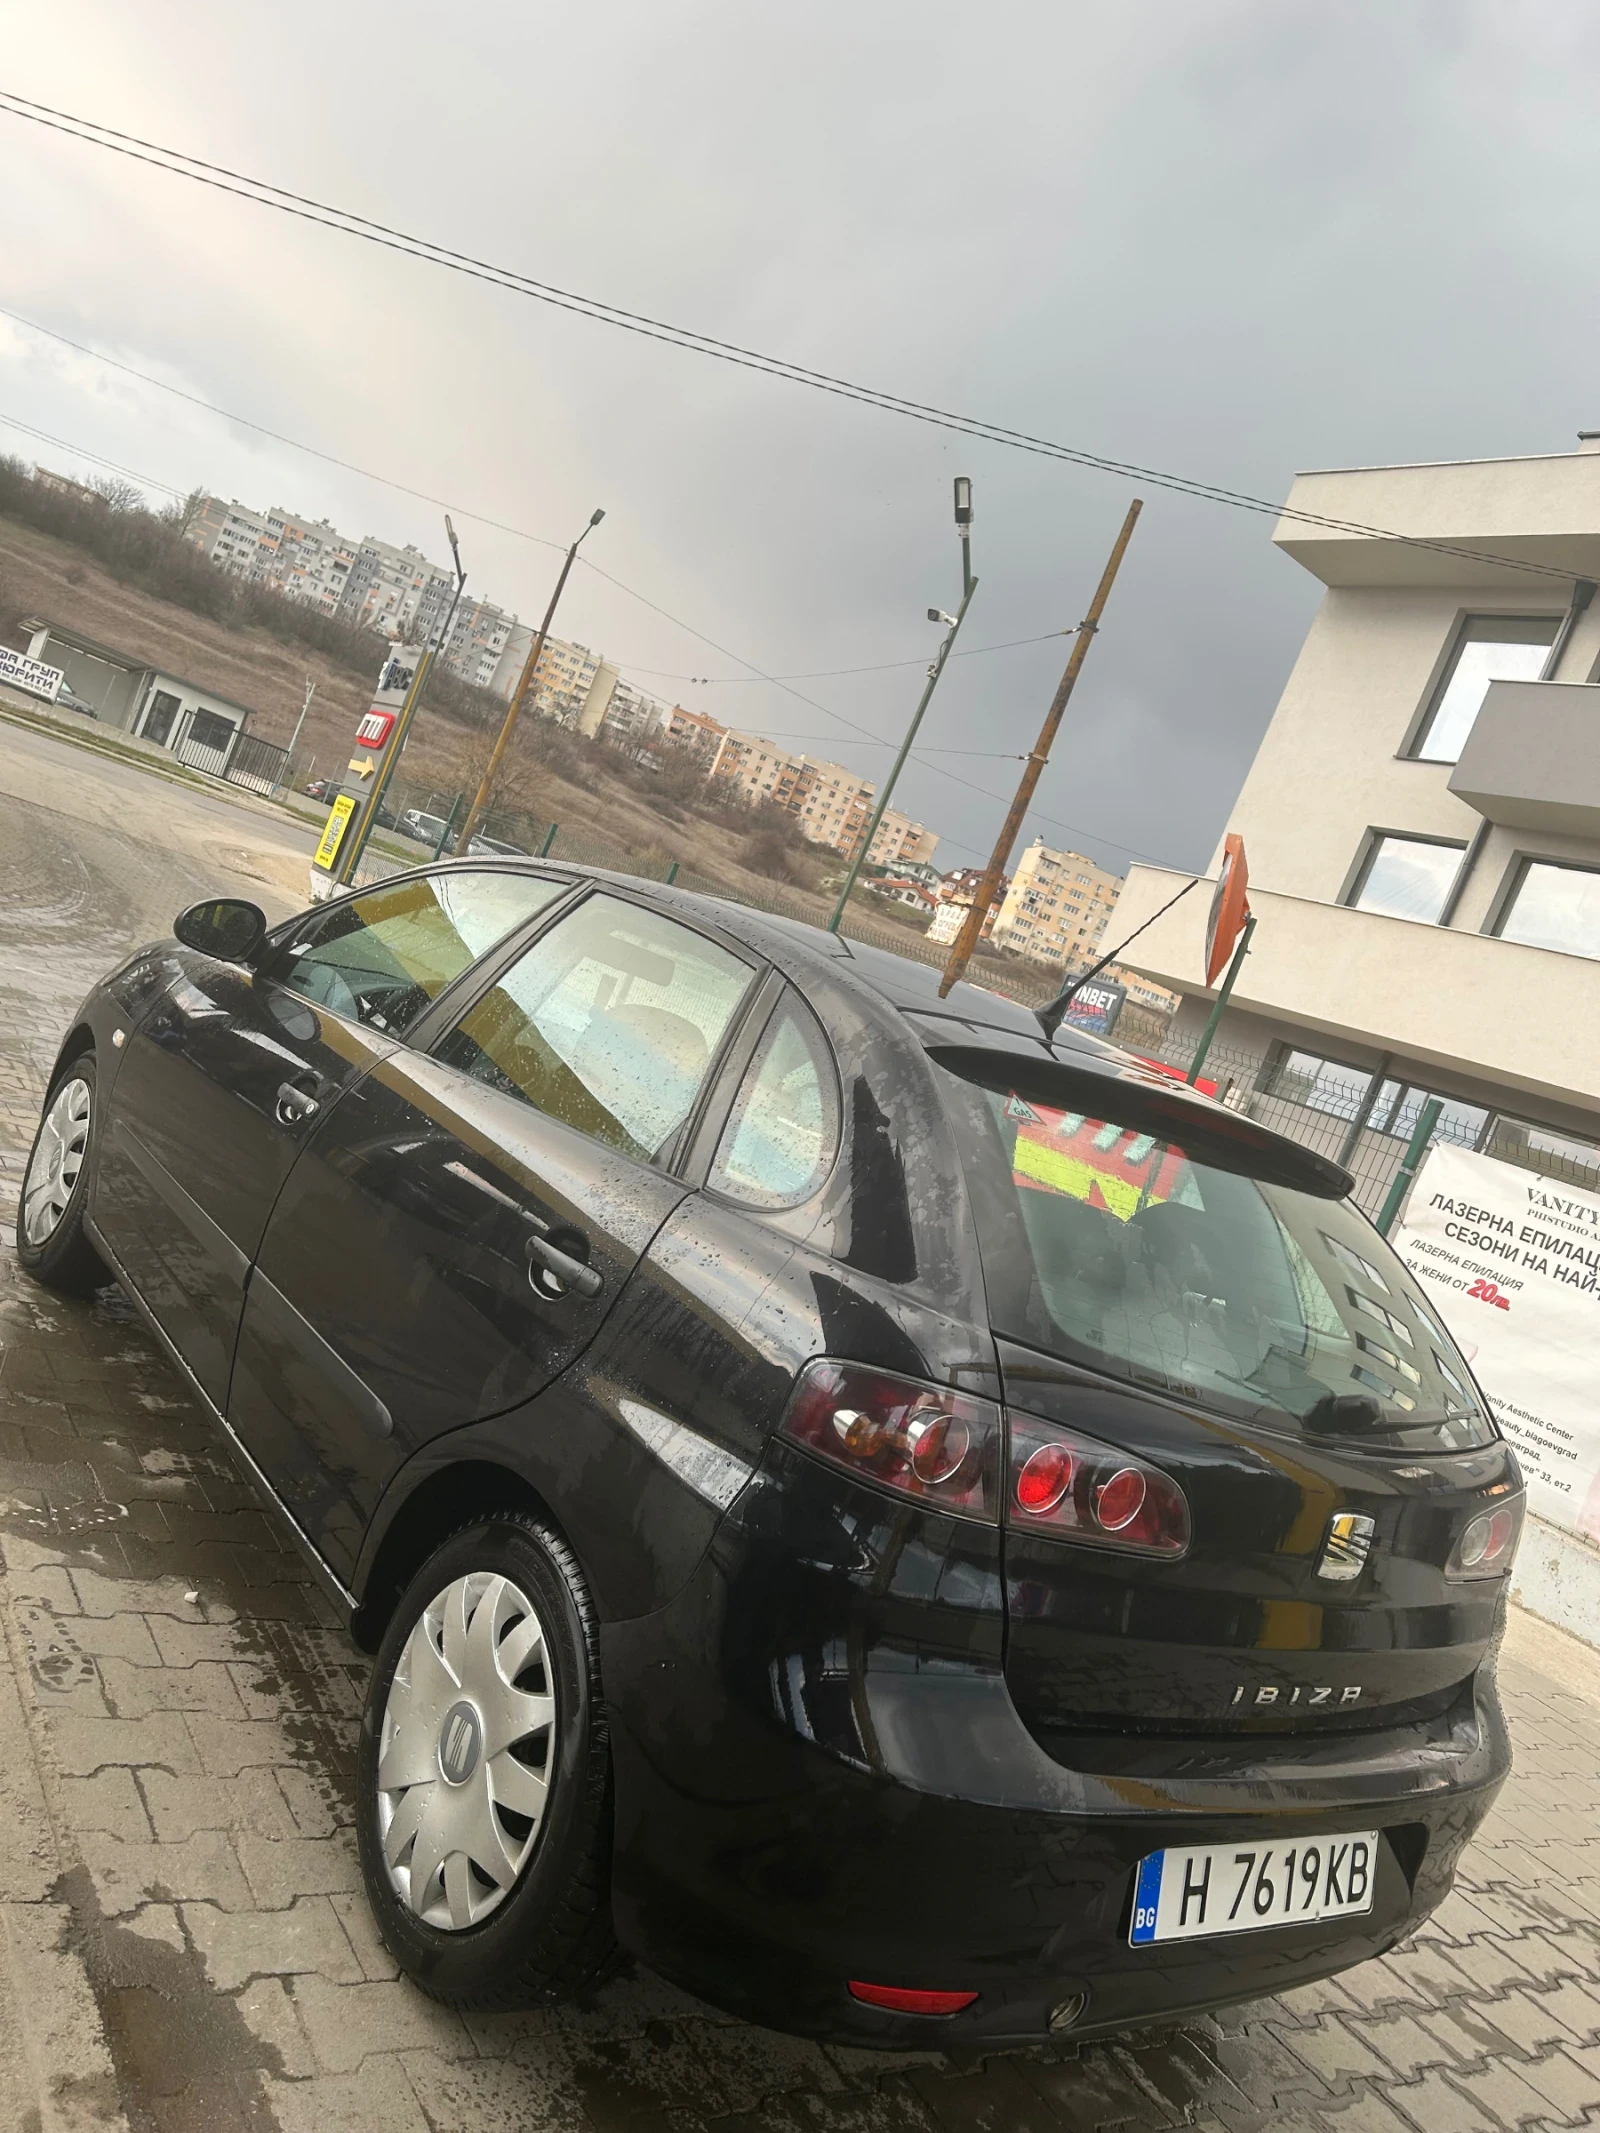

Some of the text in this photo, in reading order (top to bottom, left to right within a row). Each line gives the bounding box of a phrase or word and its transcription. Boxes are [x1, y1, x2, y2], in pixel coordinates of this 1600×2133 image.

[22, 659, 60, 681] ГРУП
[1013, 1107, 1032, 1118] GAS
[1429, 1193, 1600, 1273] ЛАЗЕРНА ЕПИЛАЦ
[1527, 1208, 1589, 1237] PHISTUDIO
[1406, 1258, 1419, 1271] ЗА
[1418, 1264, 1452, 1285] ЖЕНИ
[1452, 1279, 1470, 1291] ОТ
[1410, 1239, 1524, 1291] ЛАЗЕРНА ЕПИЛАЦИЯ
[1444, 1222, 1600, 1300] СЕЗОНИ НА НАЙ-
[1506, 1404, 1545, 1427] Aesthetic
[1545, 1422, 1574, 1441] Center
[1540, 1472, 1552, 1484] 33,
[1231, 1686, 1361, 1705] IBIZA
[1179, 1856, 1212, 1926] H
[1135, 1907, 1155, 1928] BG
